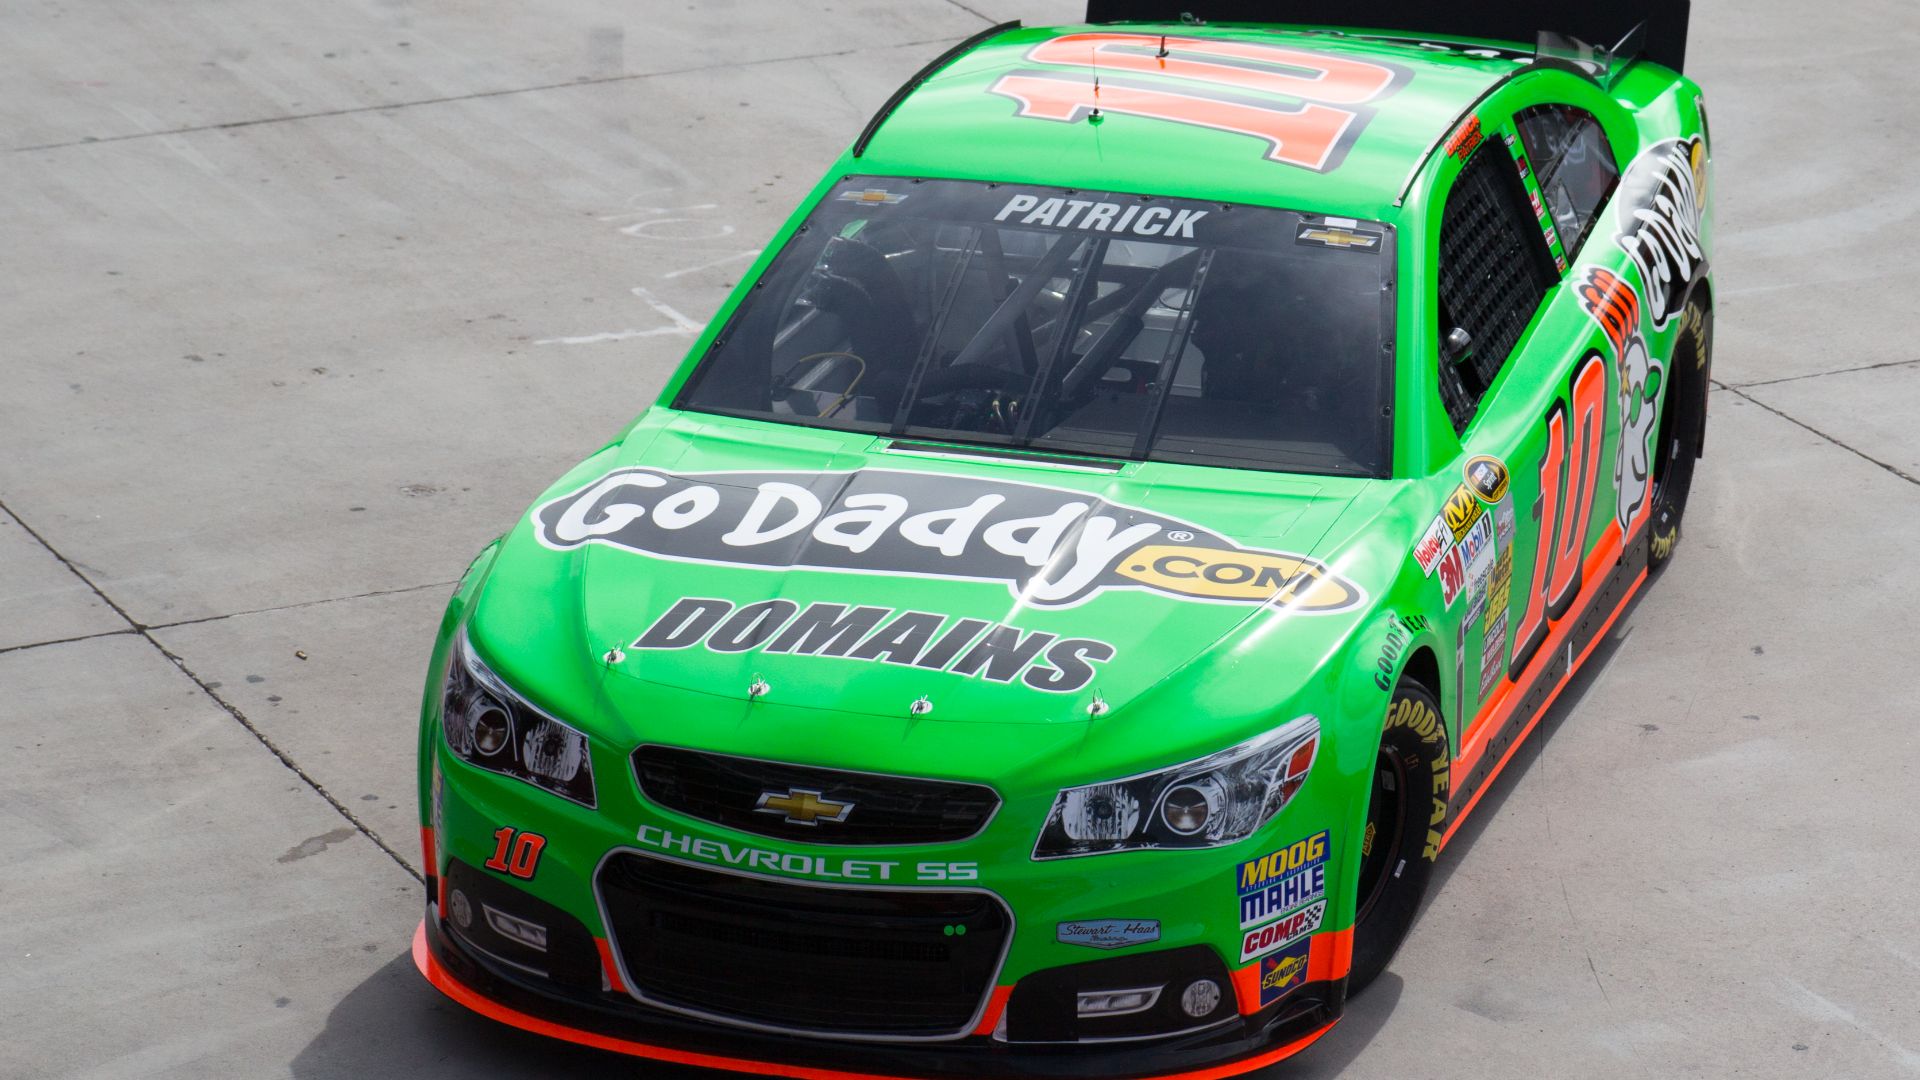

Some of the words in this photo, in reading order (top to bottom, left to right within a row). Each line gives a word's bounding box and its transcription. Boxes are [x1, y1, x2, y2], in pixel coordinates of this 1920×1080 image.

[990, 32, 1402, 173] 10
[994, 194, 1209, 239] PATRICK
[1510, 352, 1606, 668] 10
[1460, 522, 1484, 567] Mobil
[1439, 544, 1465, 606] 3M
[633, 598, 1114, 692] DOMAINS
[485, 826, 547, 880] 10
[636, 824, 899, 881] CHEVROLET
[917, 862, 979, 881] SS
[1240, 831, 1326, 889] MOOG
[1240, 863, 1324, 925] MAHLE
[1243, 911, 1306, 955] COMP
[1262, 954, 1307, 989] SUNOCO
